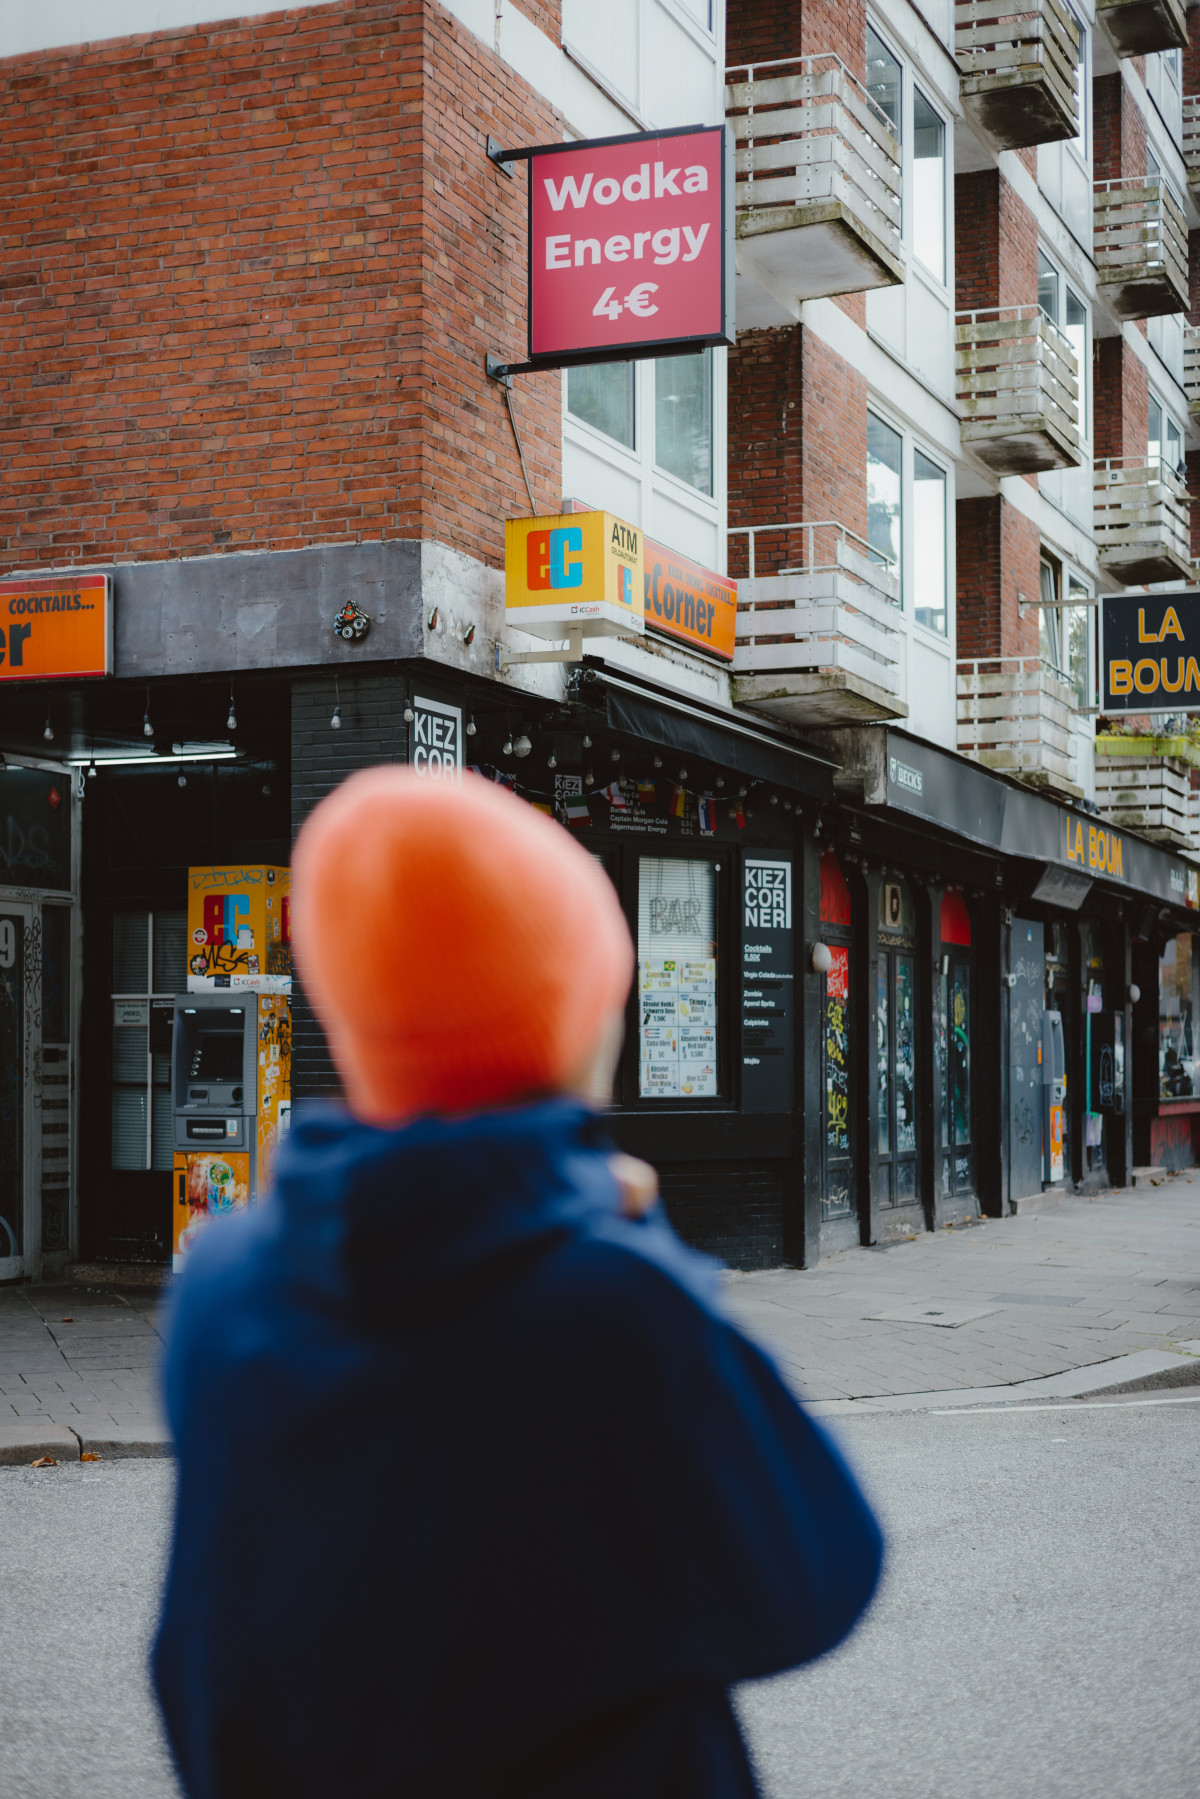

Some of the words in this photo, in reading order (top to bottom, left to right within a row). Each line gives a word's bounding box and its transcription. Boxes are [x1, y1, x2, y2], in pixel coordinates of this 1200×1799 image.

[544, 161, 708, 211] Wodka
[546, 223, 711, 271] Energy
[593, 282, 660, 321] 4€
[612, 522, 638, 554] ATM
[9, 595, 95, 615] COCKTAILS...
[1138, 606, 1186, 644] LA
[414, 711, 455, 752] KIEZ
[414, 745, 455, 785] COR
[555, 777, 578, 791] KIEZ
[610, 815, 632, 823] Captain
[633, 817, 654, 825] Morgan
[648, 825, 667, 834] Energy
[1066, 816, 1084, 864] LA
[1088, 826, 1123, 878] BOUM
[744, 869, 785, 888] KIEZ
[744, 888, 785, 908] COR
[650, 897, 700, 935] BAR
[744, 908, 785, 929] NER
[744, 944, 772, 953] Cocktails
[743, 971, 758, 979] Virgin
[759, 971, 776, 979] Colada
[743, 1057, 760, 1065] Mojito
